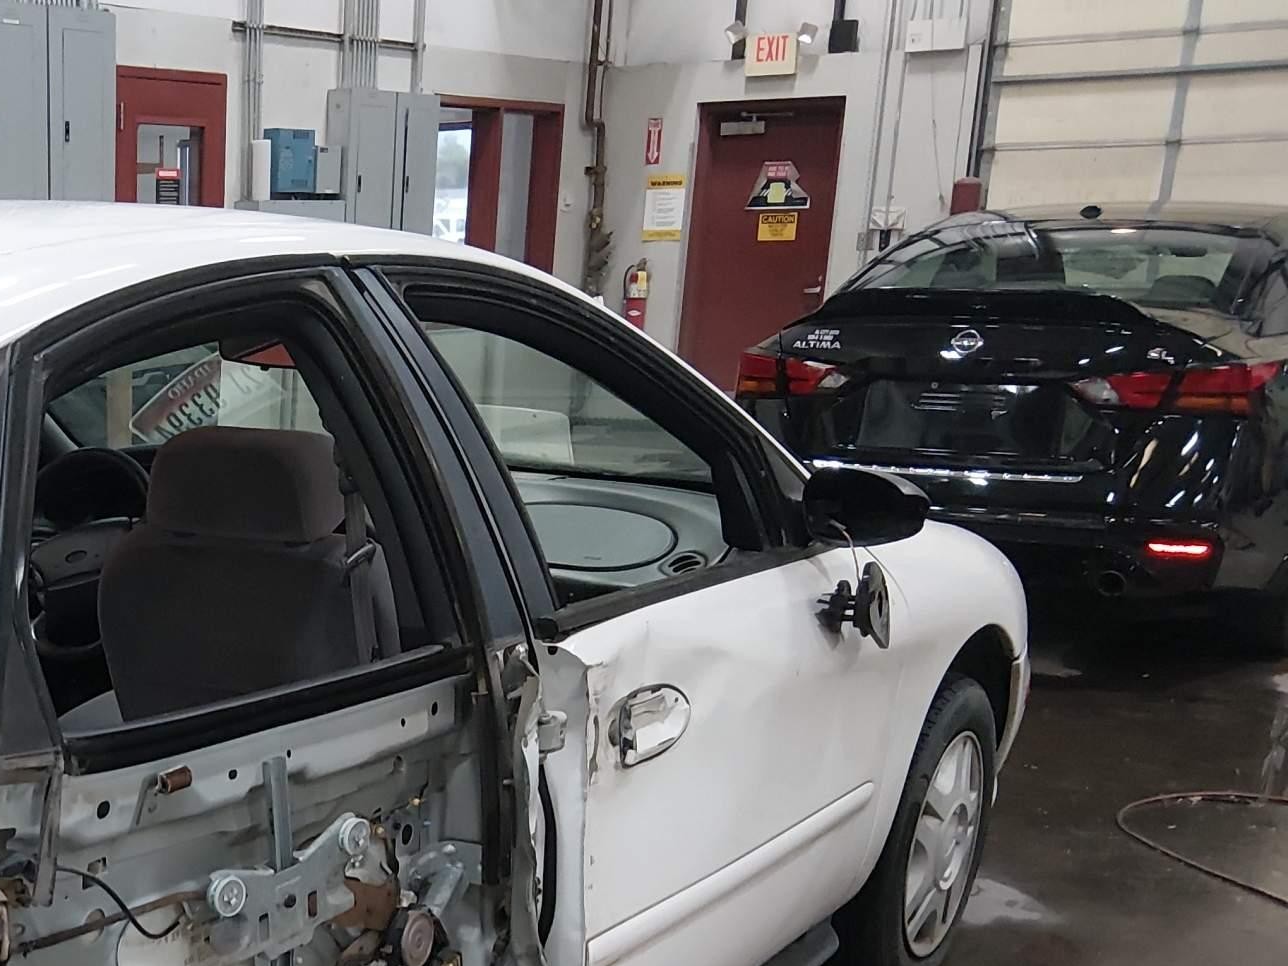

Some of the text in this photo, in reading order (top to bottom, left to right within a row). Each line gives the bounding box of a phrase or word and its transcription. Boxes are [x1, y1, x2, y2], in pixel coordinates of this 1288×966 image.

[756, 34, 789, 62] EXIT
[761, 214, 795, 224] CAUTION
[792, 340, 841, 349] ALTIMA
